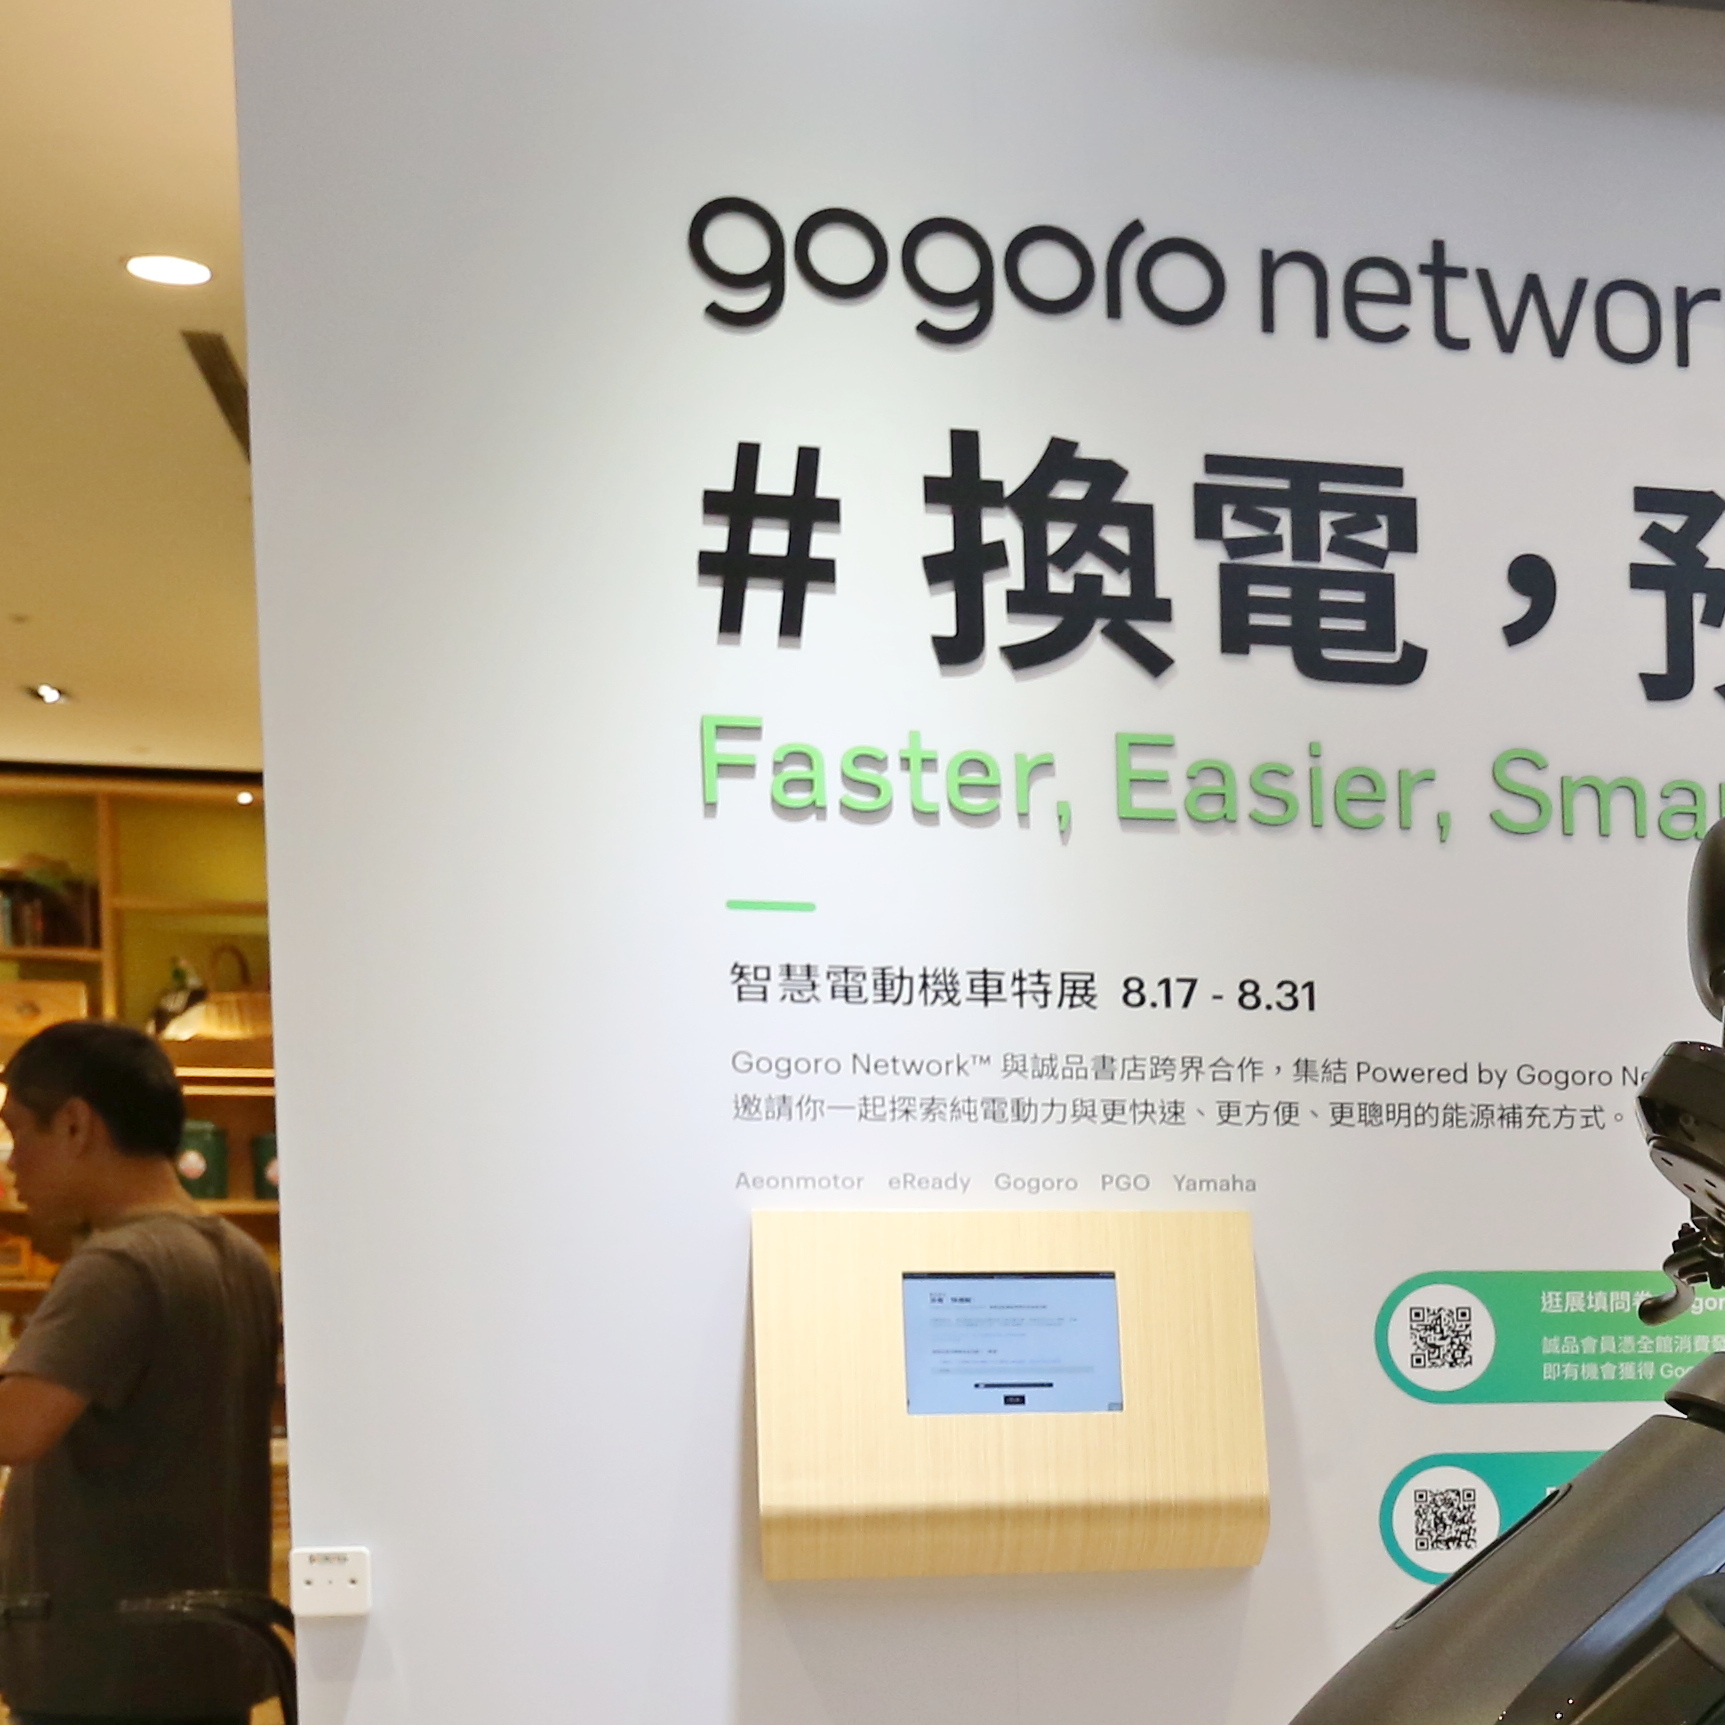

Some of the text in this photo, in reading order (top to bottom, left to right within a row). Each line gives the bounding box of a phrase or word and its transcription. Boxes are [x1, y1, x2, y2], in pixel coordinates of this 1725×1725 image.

[688, 196, 1227, 345] gogoro
[697, 441, 842, 640] #
[701, 714, 1071, 835] Faster,
[1115, 732, 1452, 842] Easier,
[729, 961, 1098, 1010] 智慧電動機車特展
[1121, 977, 1198, 1009] 8.17
[1237, 979, 1317, 1012] 8.31
[731, 1050, 842, 1080] Gogoro
[1356, 1061, 1468, 1083] Powered
[1478, 1062, 1507, 1089] by
[1516, 1064, 1613, 1090] Gogoro
[735, 1171, 1257, 1195] Aeonmotor eReady Gogoro PGO Yamaha
